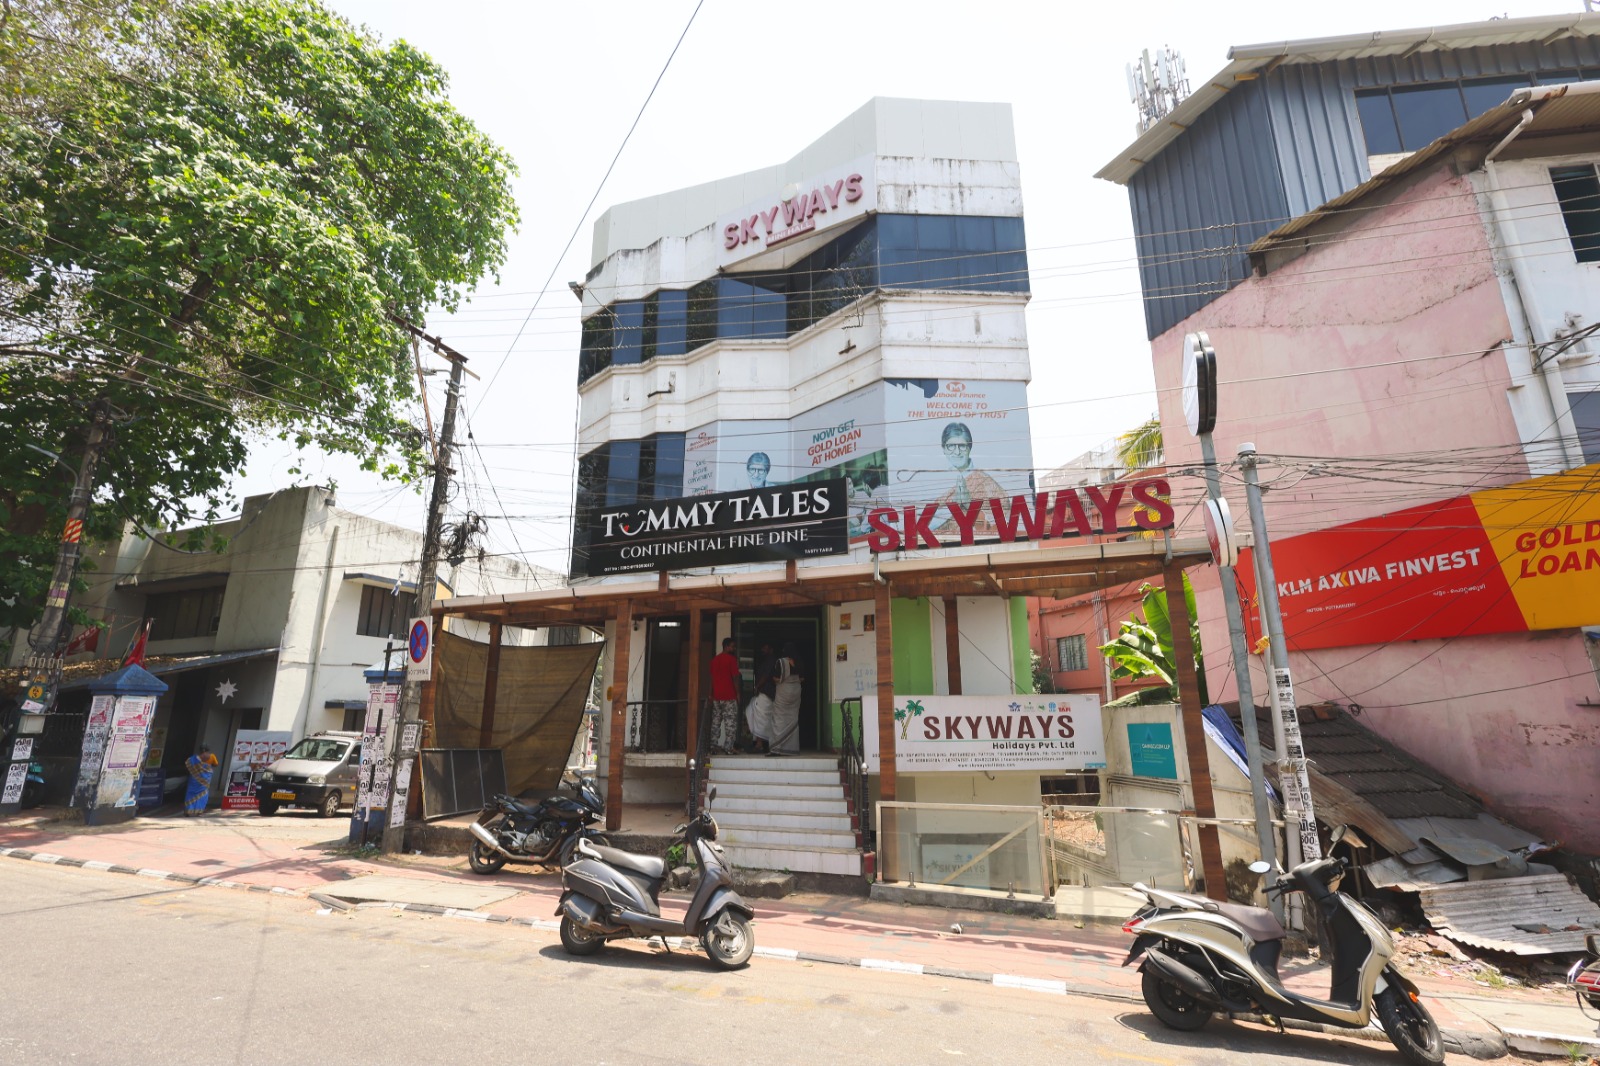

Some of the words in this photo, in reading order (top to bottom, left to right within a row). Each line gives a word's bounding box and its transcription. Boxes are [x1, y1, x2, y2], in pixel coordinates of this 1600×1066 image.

[724, 173, 863, 249] SKYWAYS
[768, 230, 786, 243] MINI
[787, 221, 812, 237] HALL
[907, 410, 925, 418] THE
[927, 411, 961, 419] WORLD
[979, 411, 1008, 419] TRUST
[926, 401, 973, 410] WELCOME
[975, 401, 988, 410] TO
[807, 440, 833, 456] GOLD
[834, 428, 862, 447] LOAN
[812, 427, 836, 444] NOW
[837, 419, 855, 434] GET
[812, 454, 823, 466] AT
[728, 486, 831, 524] TALES
[867, 478, 1175, 552] SKYWAYS
[620, 538, 726, 561] CONTINENTAL
[729, 532, 765, 549] FINE
[768, 528, 809, 545] DINE
[1515, 519, 1600, 553] GOLD
[1278, 578, 1313, 598] KLM
[1384, 547, 1482, 581] FINVEST
[1519, 550, 1600, 579] LOAN
[923, 715, 1075, 741] SKYWAYS
[992, 741, 1036, 752] Holidays
[1038, 741, 1059, 750] Pvt.
[1060, 740, 1075, 749] Ltd
